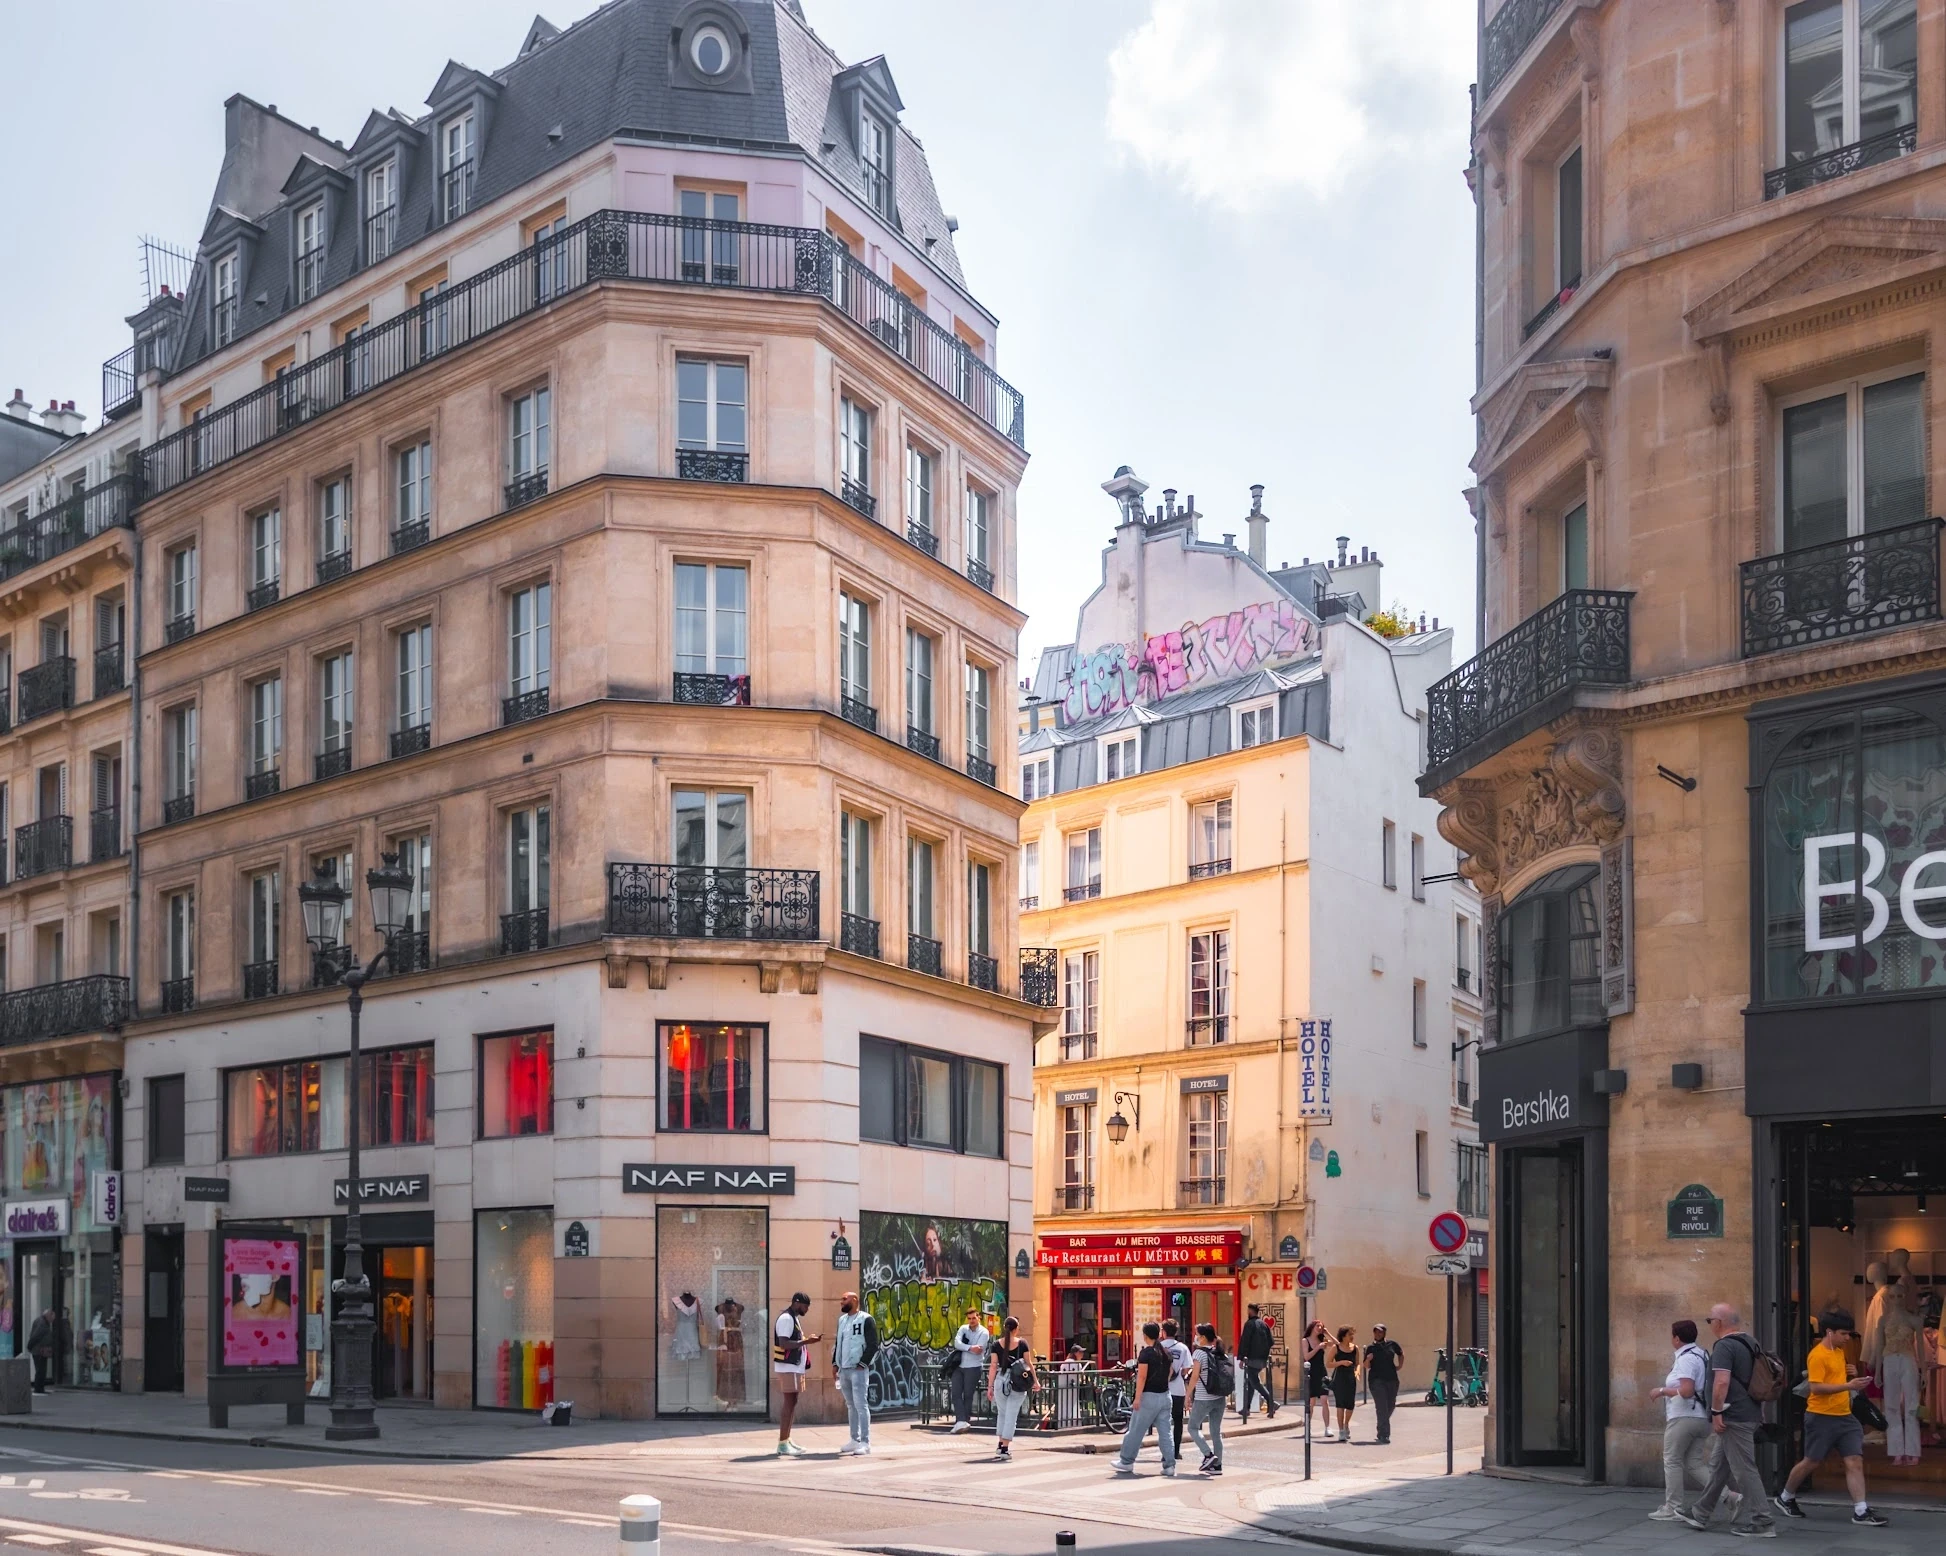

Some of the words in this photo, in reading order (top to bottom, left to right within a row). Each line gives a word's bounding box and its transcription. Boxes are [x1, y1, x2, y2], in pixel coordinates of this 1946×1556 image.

[1300, 1021, 1316, 1103] HOTEL
[1320, 1021, 1331, 1104] HOTEL
[1190, 1079, 1218, 1089] HOTEL
[1064, 1092, 1089, 1102] HOTEL
[1503, 1089, 1570, 1129] Bershka
[631, 1169, 705, 1187] NAF
[714, 1171, 787, 1188] NAF
[379, 1180, 420, 1197] NAF
[1686, 1206, 1704, 1215] RUE
[1681, 1222, 1709, 1231] RIVOLI
[1069, 1238, 1087, 1247] BAR
[1115, 1237, 1127, 1246] AU
[1130, 1236, 1161, 1246] METRO
[1175, 1235, 1225, 1245] BRASSERIE
[1041, 1252, 1059, 1264] Bar
[1062, 1251, 1120, 1263] Restaurant
[1124, 1250, 1141, 1263] AU
[1145, 1248, 1189, 1262] MÉTRO
[1247, 1273, 1293, 1290] CFE
[852, 1323, 862, 1336] H
